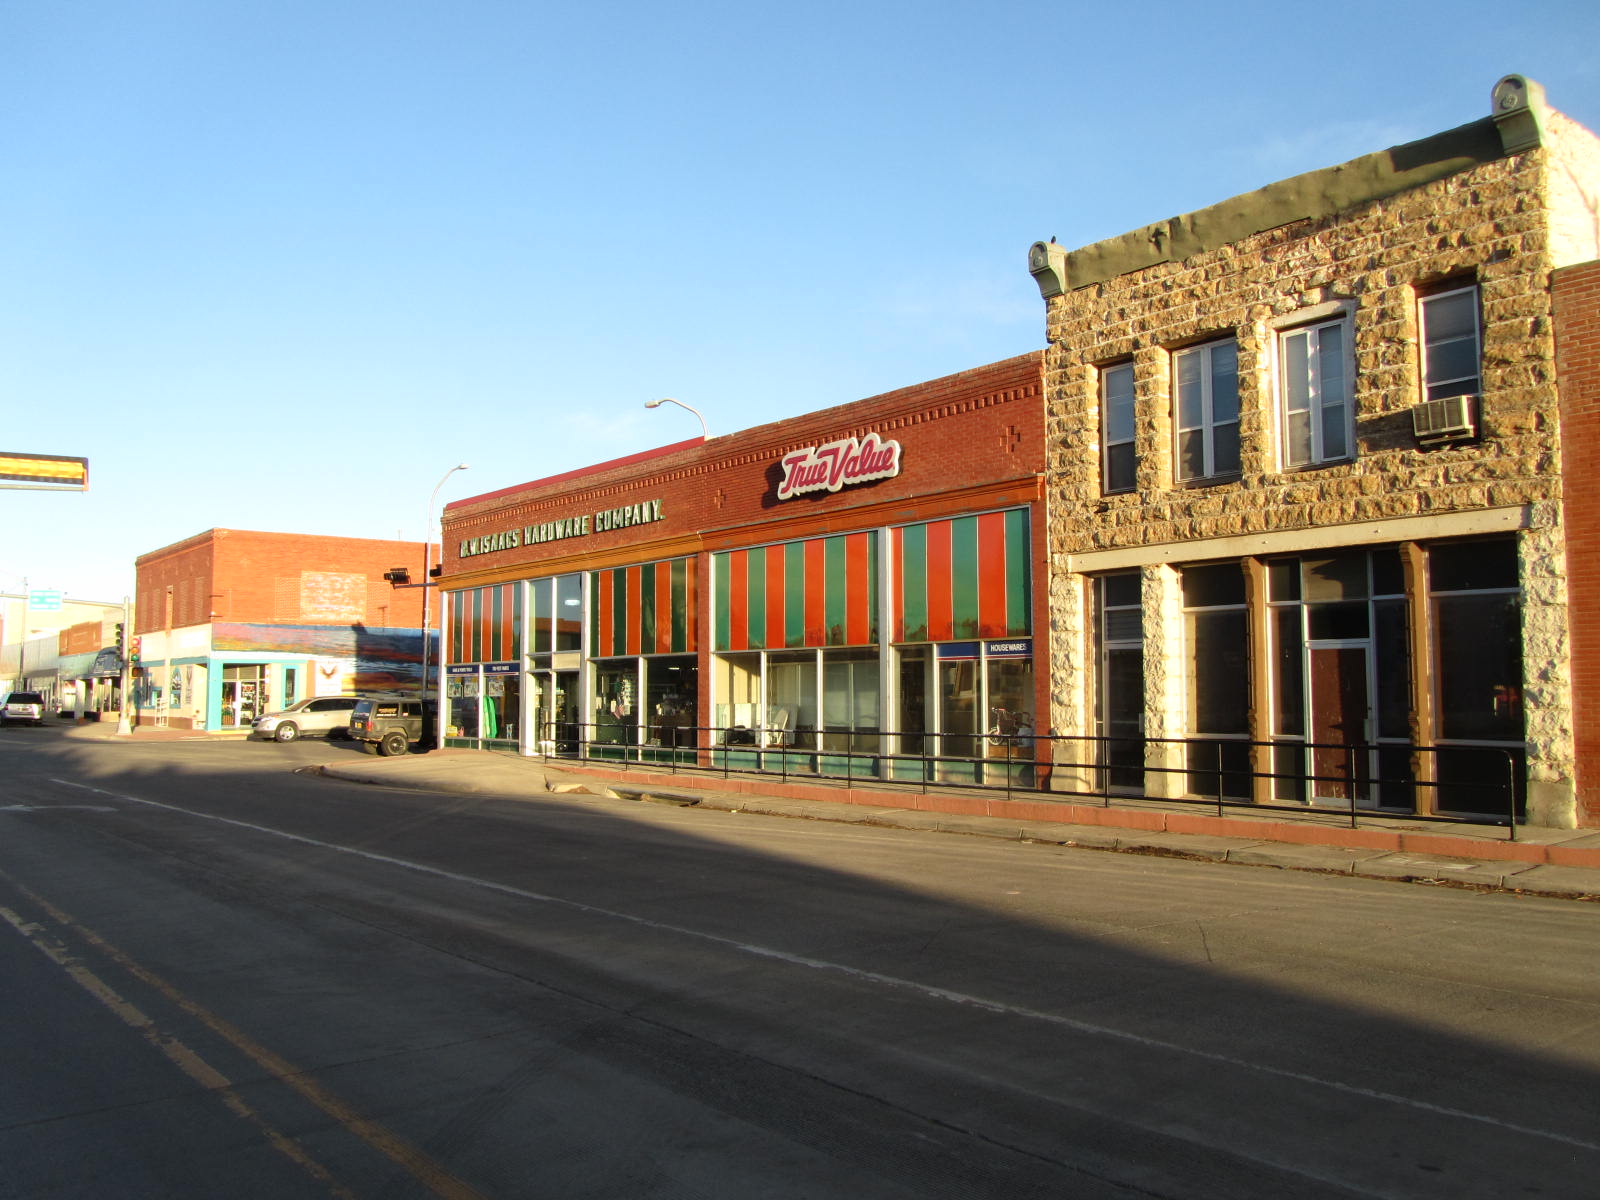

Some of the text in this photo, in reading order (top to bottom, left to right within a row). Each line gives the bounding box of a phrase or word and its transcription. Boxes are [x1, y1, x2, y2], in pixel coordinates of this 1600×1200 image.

[781, 439, 895, 494] True Value
[524, 516, 590, 545] HARDWARE
[990, 643, 1027, 652] HOUSEWARES
